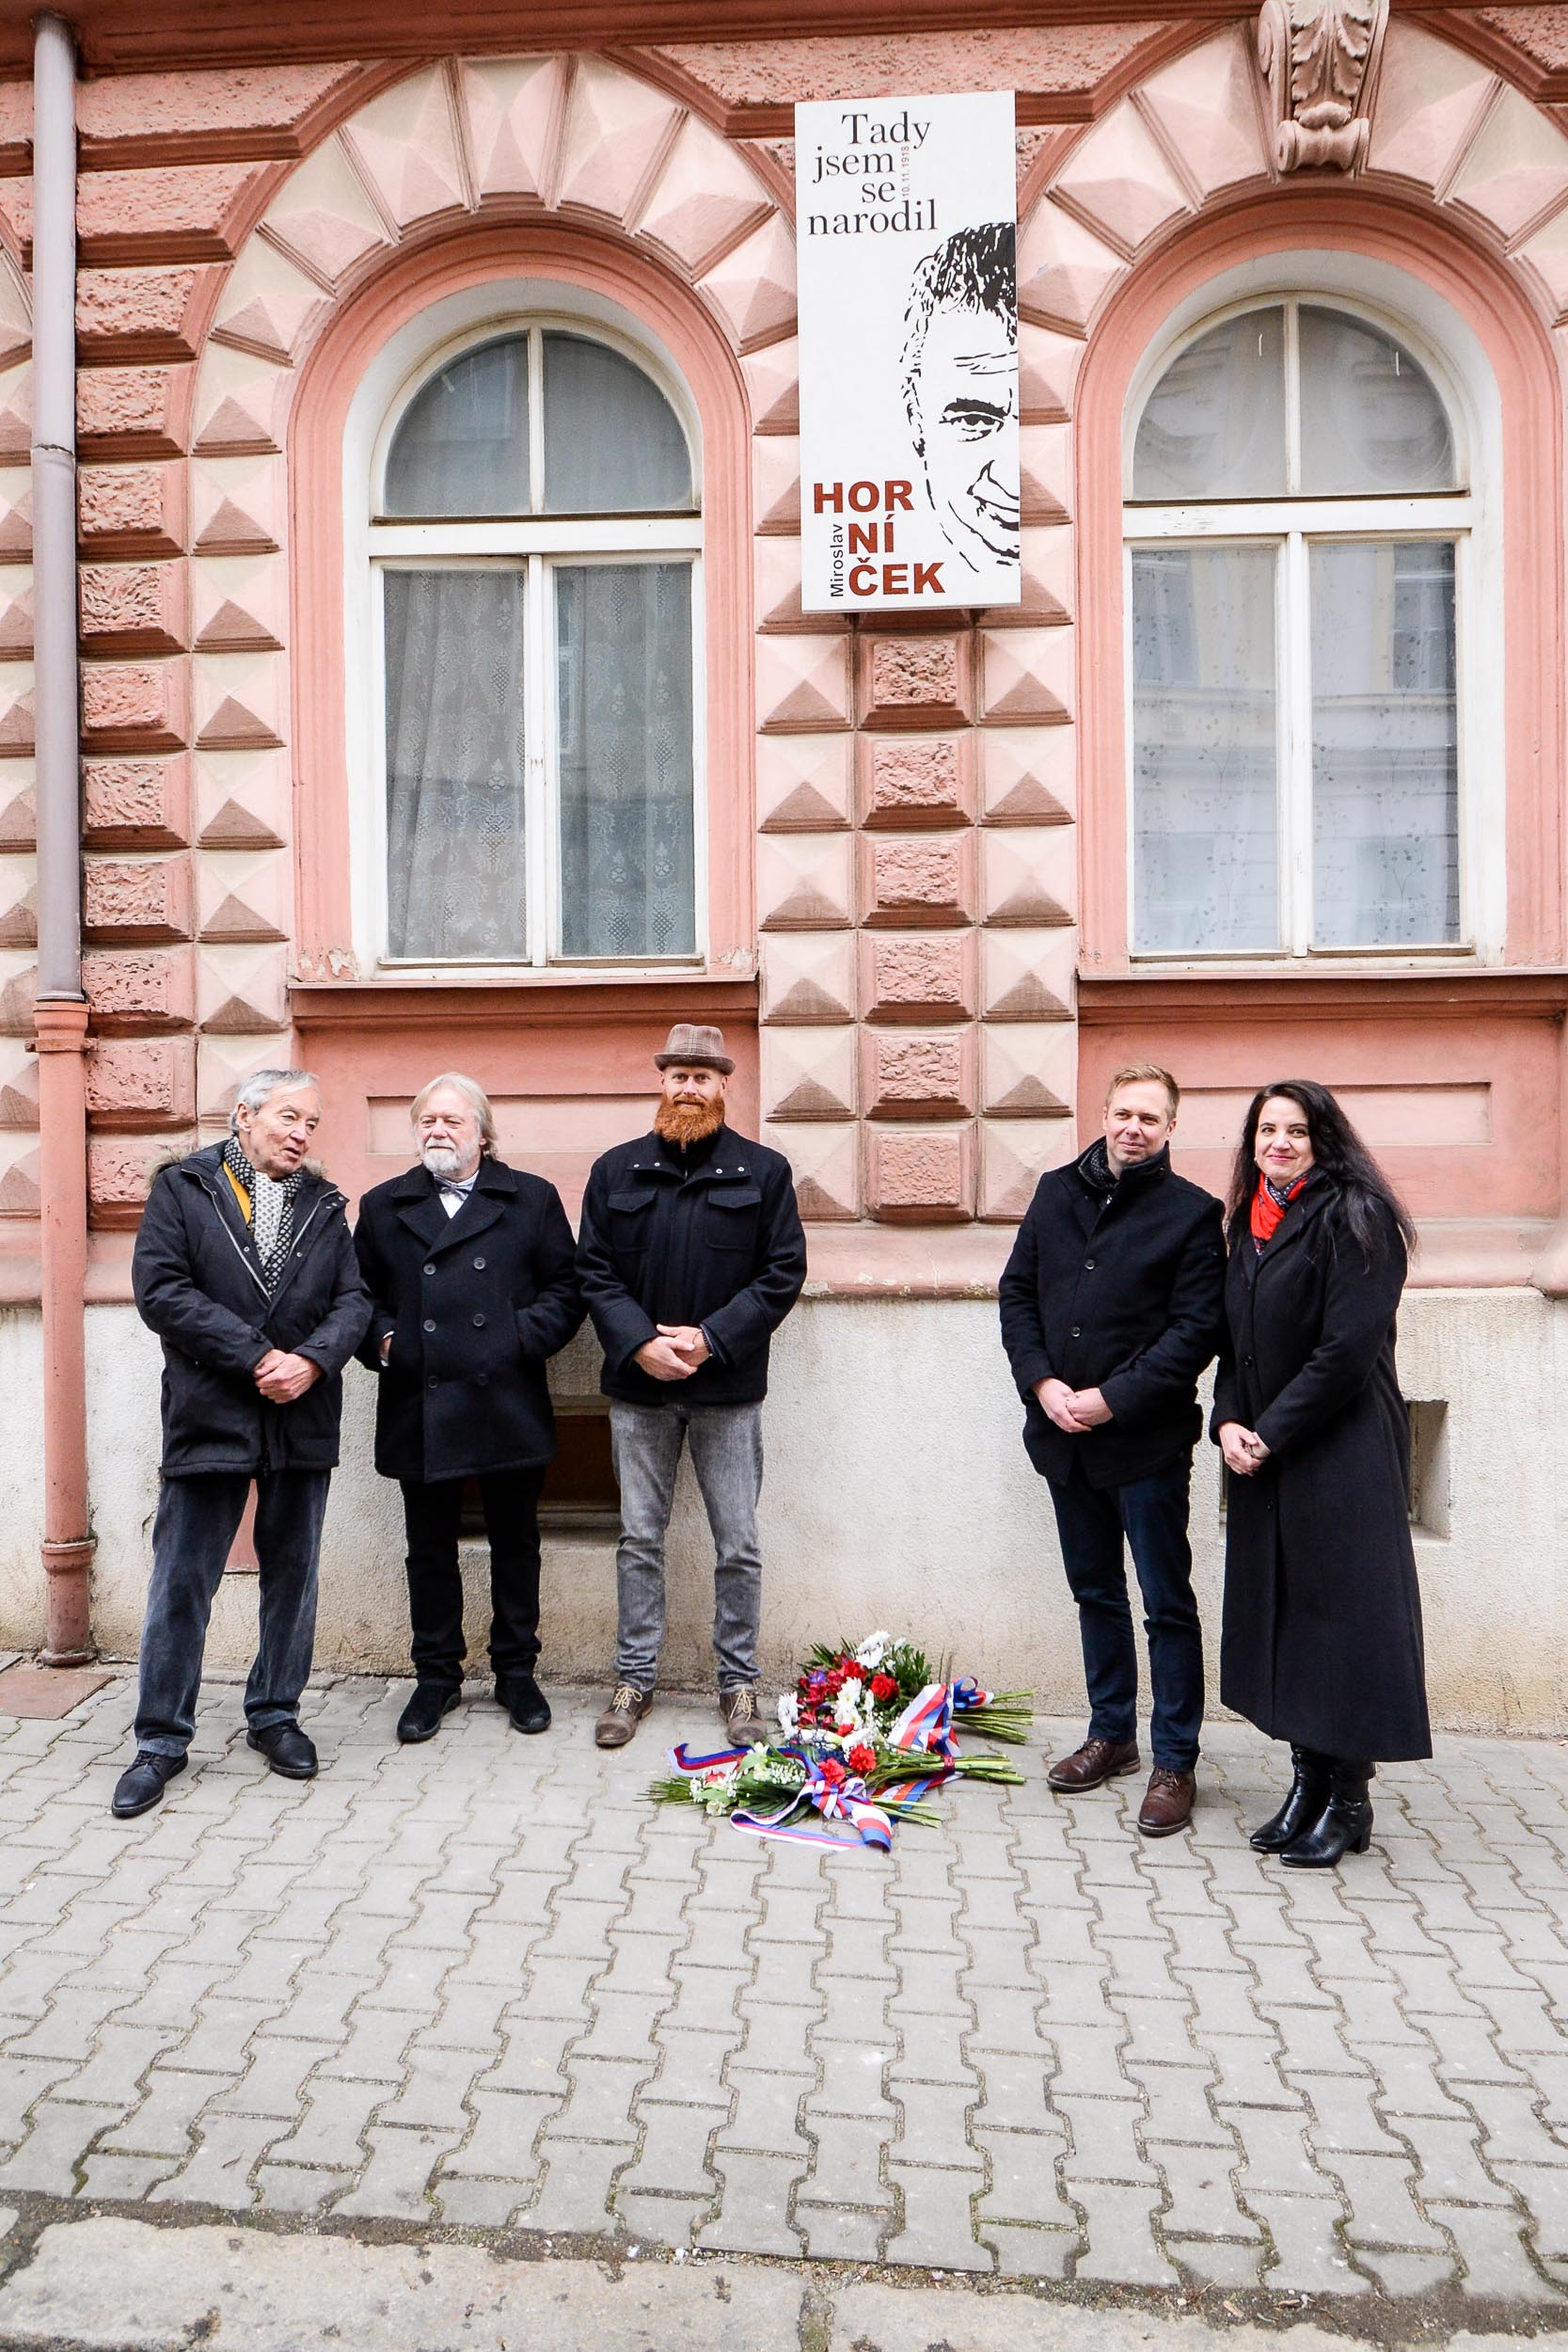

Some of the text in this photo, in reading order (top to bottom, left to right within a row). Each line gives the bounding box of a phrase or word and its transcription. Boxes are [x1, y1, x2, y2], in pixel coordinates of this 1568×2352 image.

[841, 111, 932, 150] Tady
[813, 146, 895, 183] jsem
[862, 181, 895, 203] se
[807, 199, 939, 235] narodil
[813, 480, 914, 514] HOR
[847, 513, 895, 554] NÍ
[830, 524, 844, 597] Miroslav
[848, 557, 946, 596] ČEK
